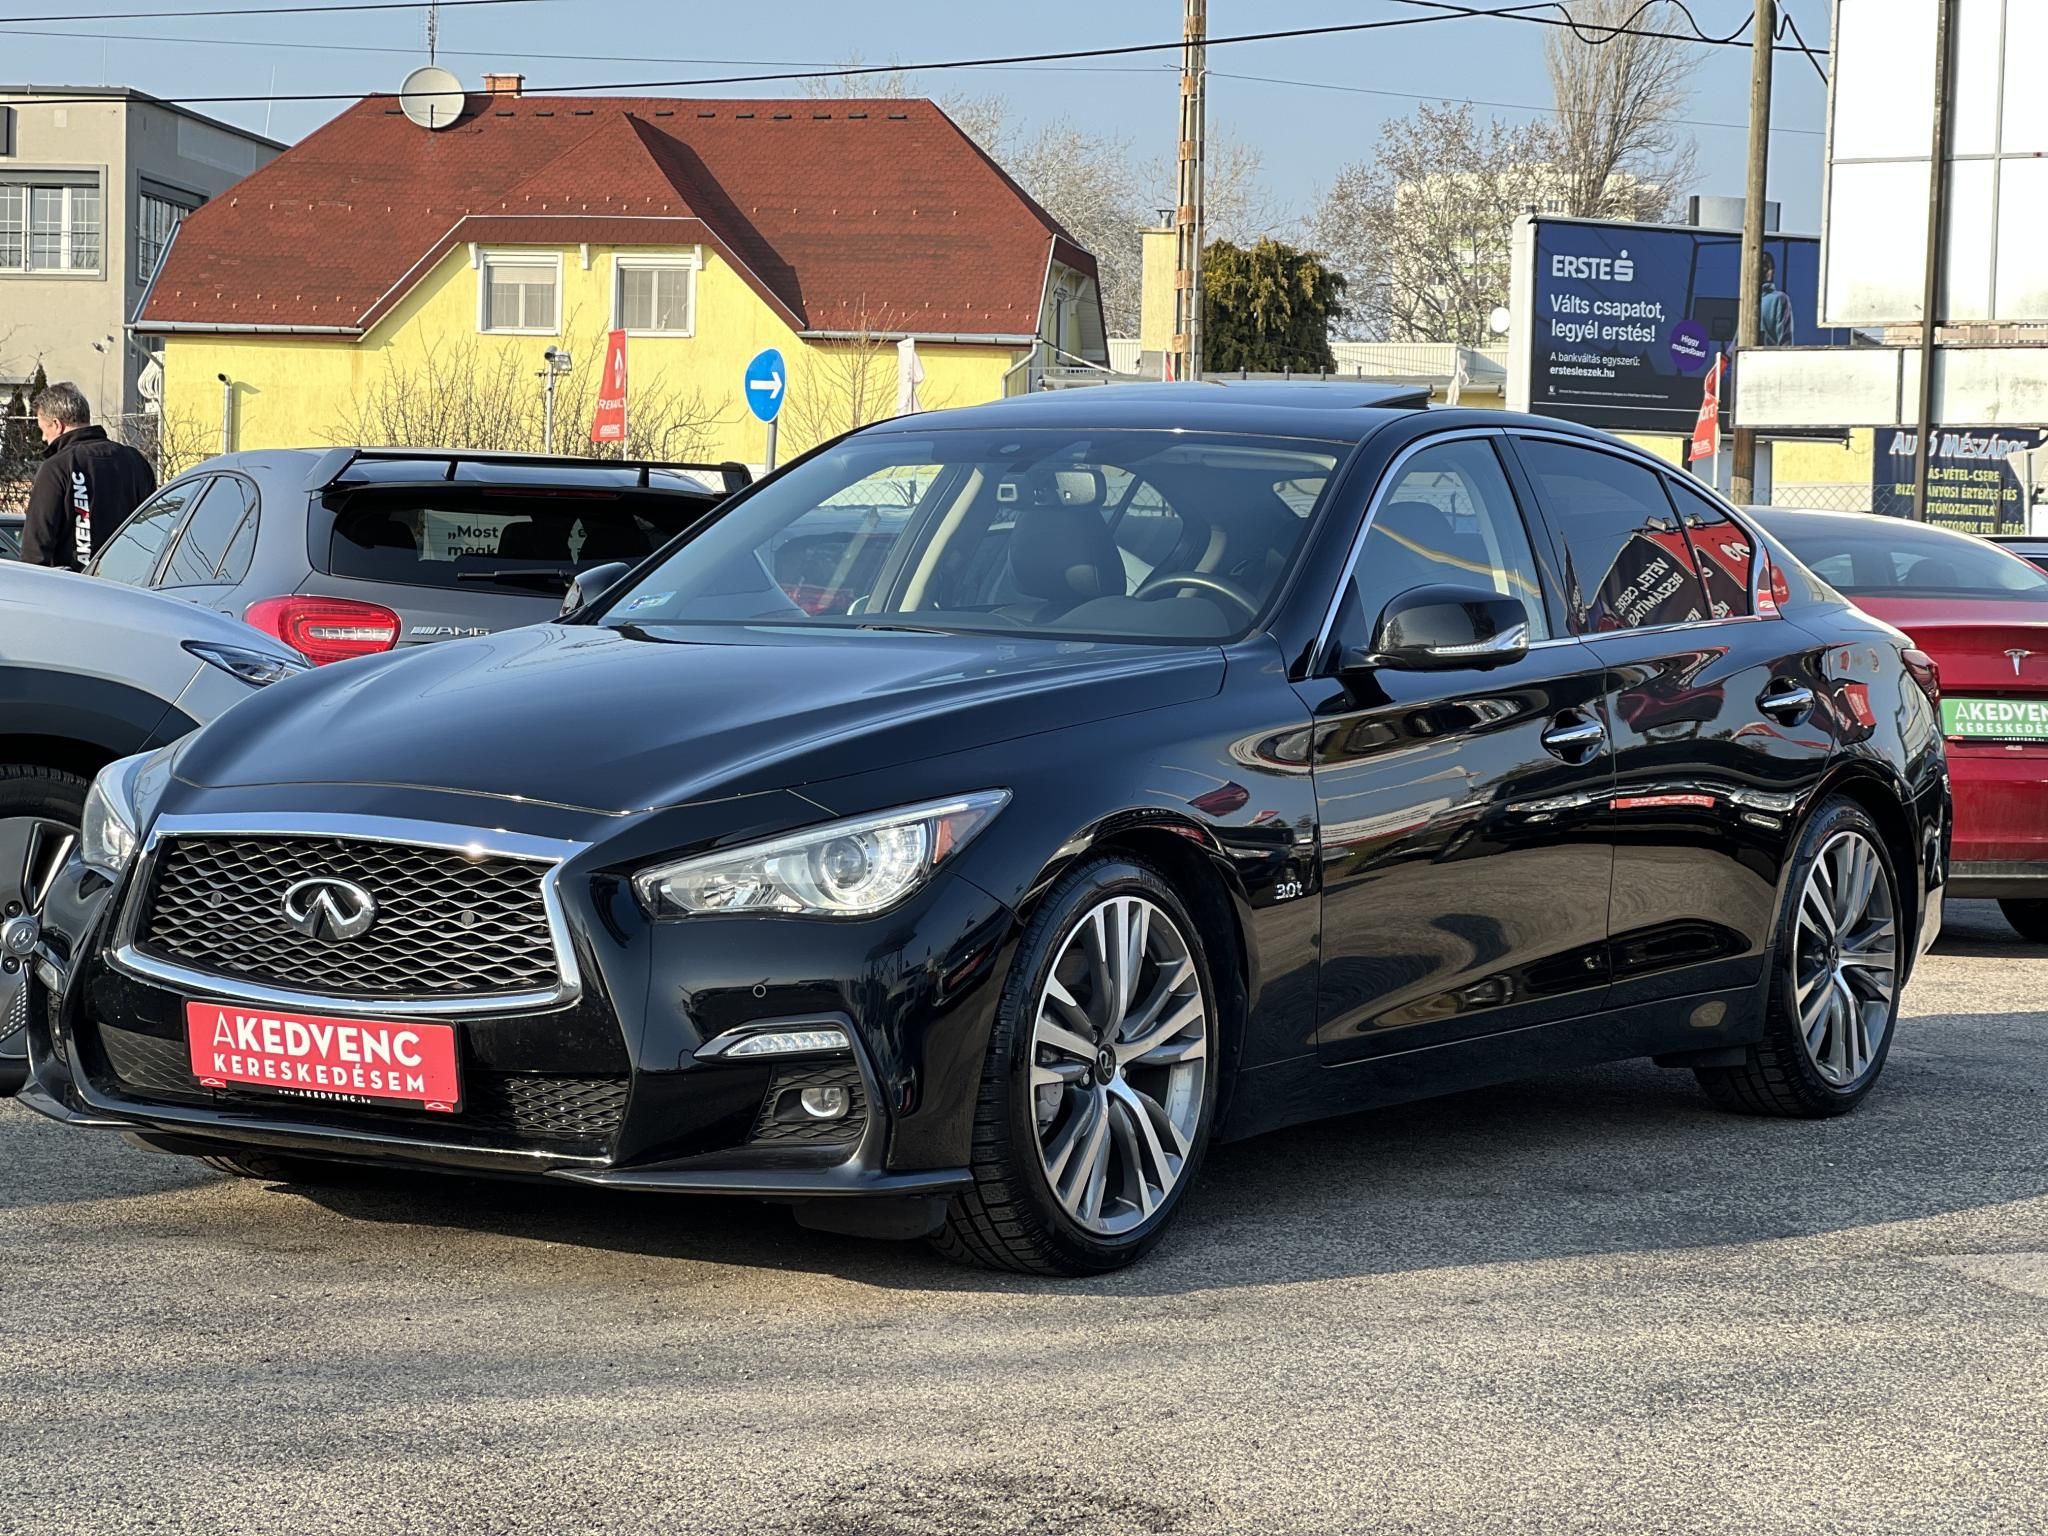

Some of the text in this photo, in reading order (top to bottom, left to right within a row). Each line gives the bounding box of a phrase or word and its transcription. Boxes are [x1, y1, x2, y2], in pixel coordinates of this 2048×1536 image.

[1550, 293, 1665, 322] Válts csapatot,
[1551, 318, 1656, 342] legyél erstés!
[1680, 334, 1700, 347] Higgy
[1671, 343, 1706, 358] magadban!
[1550, 352, 1641, 367] A bankváltás egyszerű:
[1550, 366, 1615, 378] erstesleszek.hu
[437, 625, 490, 636] AMG
[213, 1011, 422, 1067] AKEDVENC
[213, 1053, 425, 1093] KERESKEDÉSEM
[277, 1089, 372, 1104] www.AKEDVENC.hu
